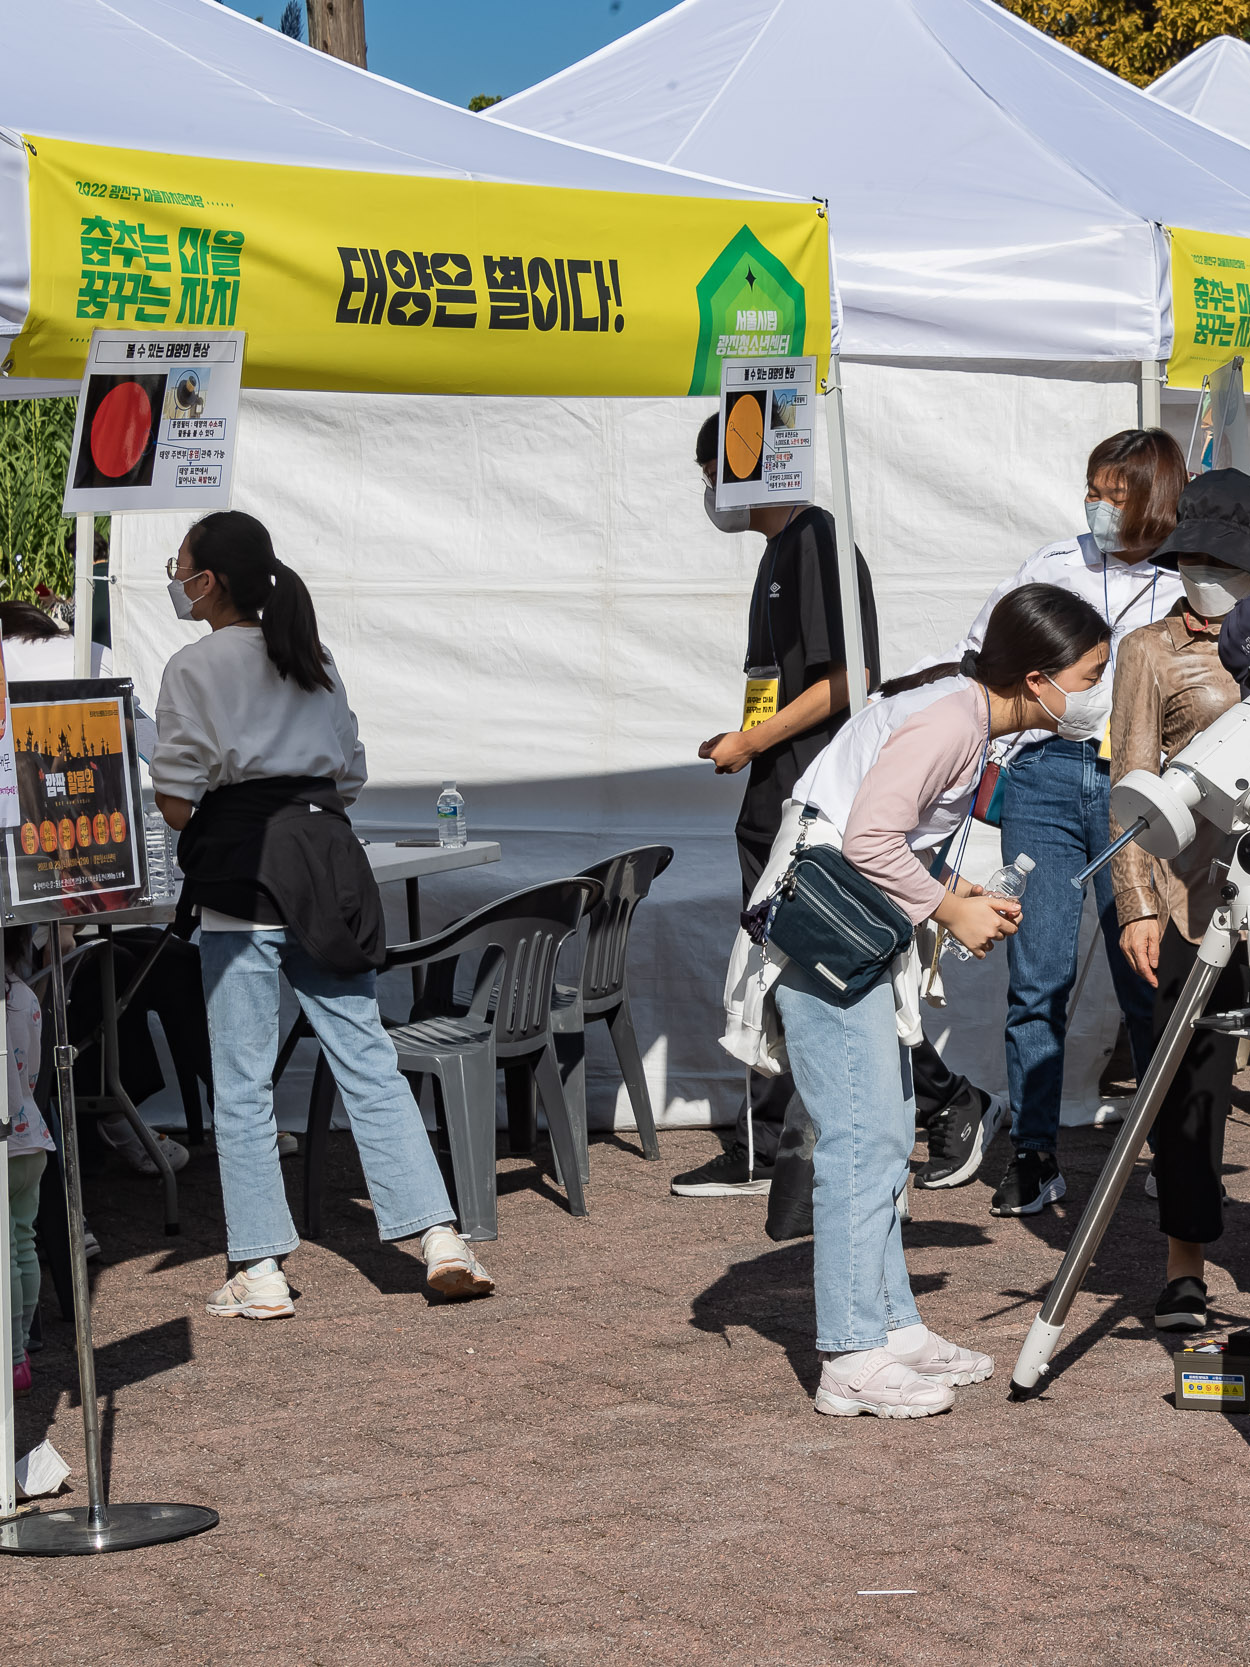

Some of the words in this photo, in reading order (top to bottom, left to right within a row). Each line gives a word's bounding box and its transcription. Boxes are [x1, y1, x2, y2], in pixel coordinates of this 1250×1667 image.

[75, 181, 108, 197] 2022
[110, 185, 142, 201] 광진구
[143, 188, 205, 208] 마을자치한마당
[80, 215, 171, 273] 춤추는
[178, 227, 245, 277] 마을
[76, 270, 171, 323] 꿈꾸는
[175, 277, 241, 326] 자치
[335, 246, 478, 329] 태양은
[483, 254, 625, 334] 별이다!
[1193, 276, 1235, 313] 춤추는
[736, 310, 777, 331] 서울시립
[1193, 312, 1235, 347] 꿈꾸는
[126, 343, 136, 359] 볼
[137, 344, 146, 358] 수
[147, 344, 165, 358] 있는
[165, 343, 191, 358] 태양의
[192, 342, 211, 358] 현상
[716, 334, 790, 356] 광진청소년센터
[744, 369, 750, 381] 볼
[750, 369, 756, 380] 수
[757, 368, 768, 380] 있는
[768, 367, 784, 380] 태양의
[784, 366, 796, 379] 현상
[160, 450, 170, 459] 태양
[213, 450, 225, 459] 가능
[179, 467, 189, 475] 태양
[189, 467, 209, 475] 표면에서
[45, 772, 67, 797] 깜짝
